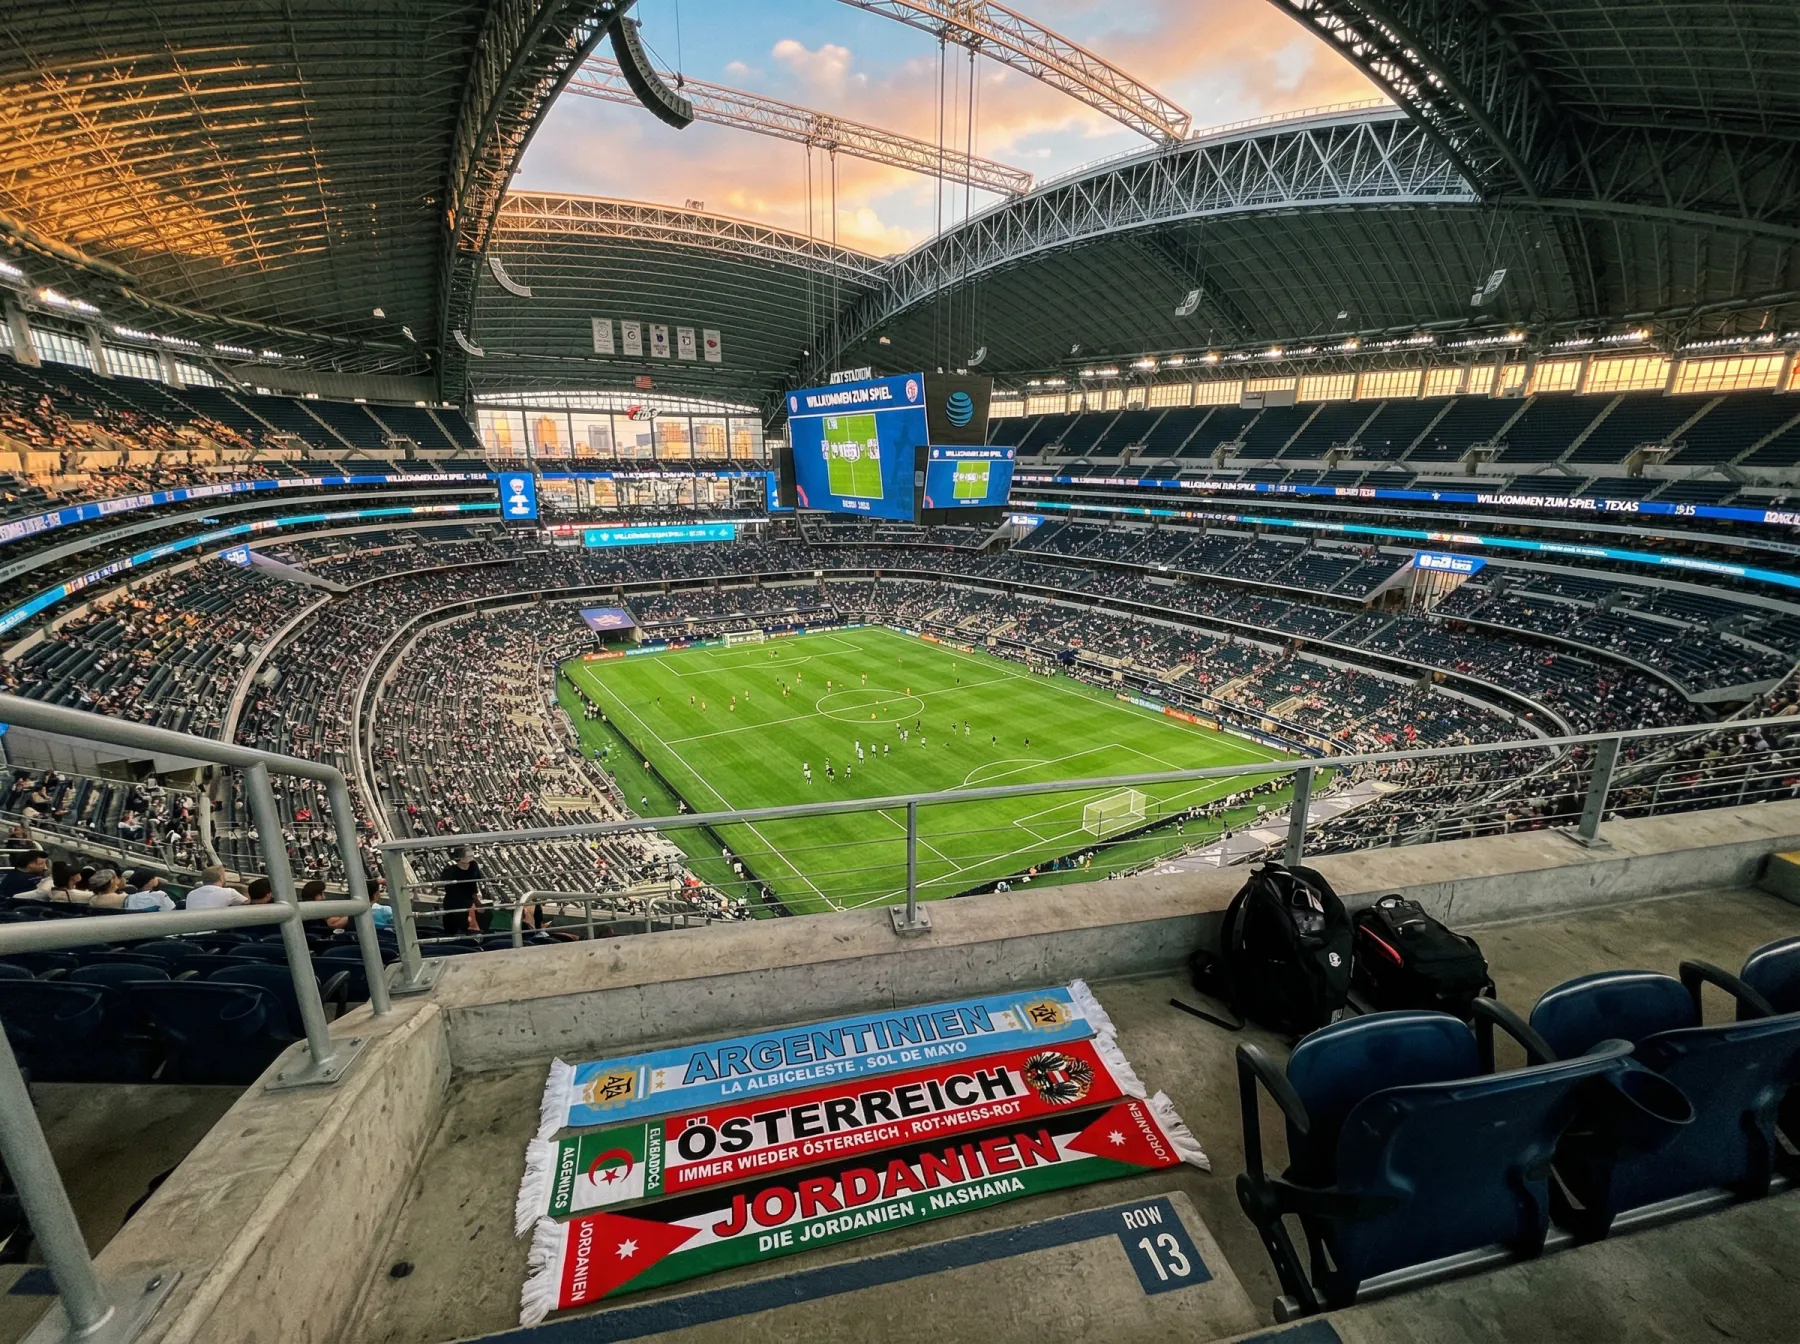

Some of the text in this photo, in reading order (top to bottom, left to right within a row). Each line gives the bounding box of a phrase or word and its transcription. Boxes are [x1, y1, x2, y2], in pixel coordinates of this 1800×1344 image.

[1477, 494, 1544, 506] WILLKOMMEN
[1544, 497, 1568, 508] ZUM
[1569, 498, 1596, 510] SPIEL
[1605, 500, 1639, 512] TEXAS
[682, 1005, 995, 1084] ARGENTINIEN
[721, 1083, 740, 1096] LA
[746, 1060, 856, 1091] ALBICELESTE
[866, 1053, 897, 1069] SOL
[900, 1049, 922, 1063] DE
[925, 1041, 968, 1059] MAYO
[677, 1066, 1017, 1161] ÖSTERREICH
[679, 1157, 734, 1183] IMMER
[737, 1146, 799, 1170] WIEDER
[803, 1125, 900, 1156] ÖSTERREICH
[911, 1101, 1022, 1134] ROT-WEISS-ROT
[1128, 1102, 1170, 1163] JORDANIEN
[712, 1129, 1061, 1238] JORDANIEN
[759, 1229, 794, 1252] DIE
[799, 1200, 915, 1243] JORDANIEN
[929, 1176, 1026, 1211] NASHAMA
[1121, 1205, 1163, 1230] ROW
[570, 1220, 594, 1302] JORDANIEN
[1138, 1232, 1191, 1282] 13
